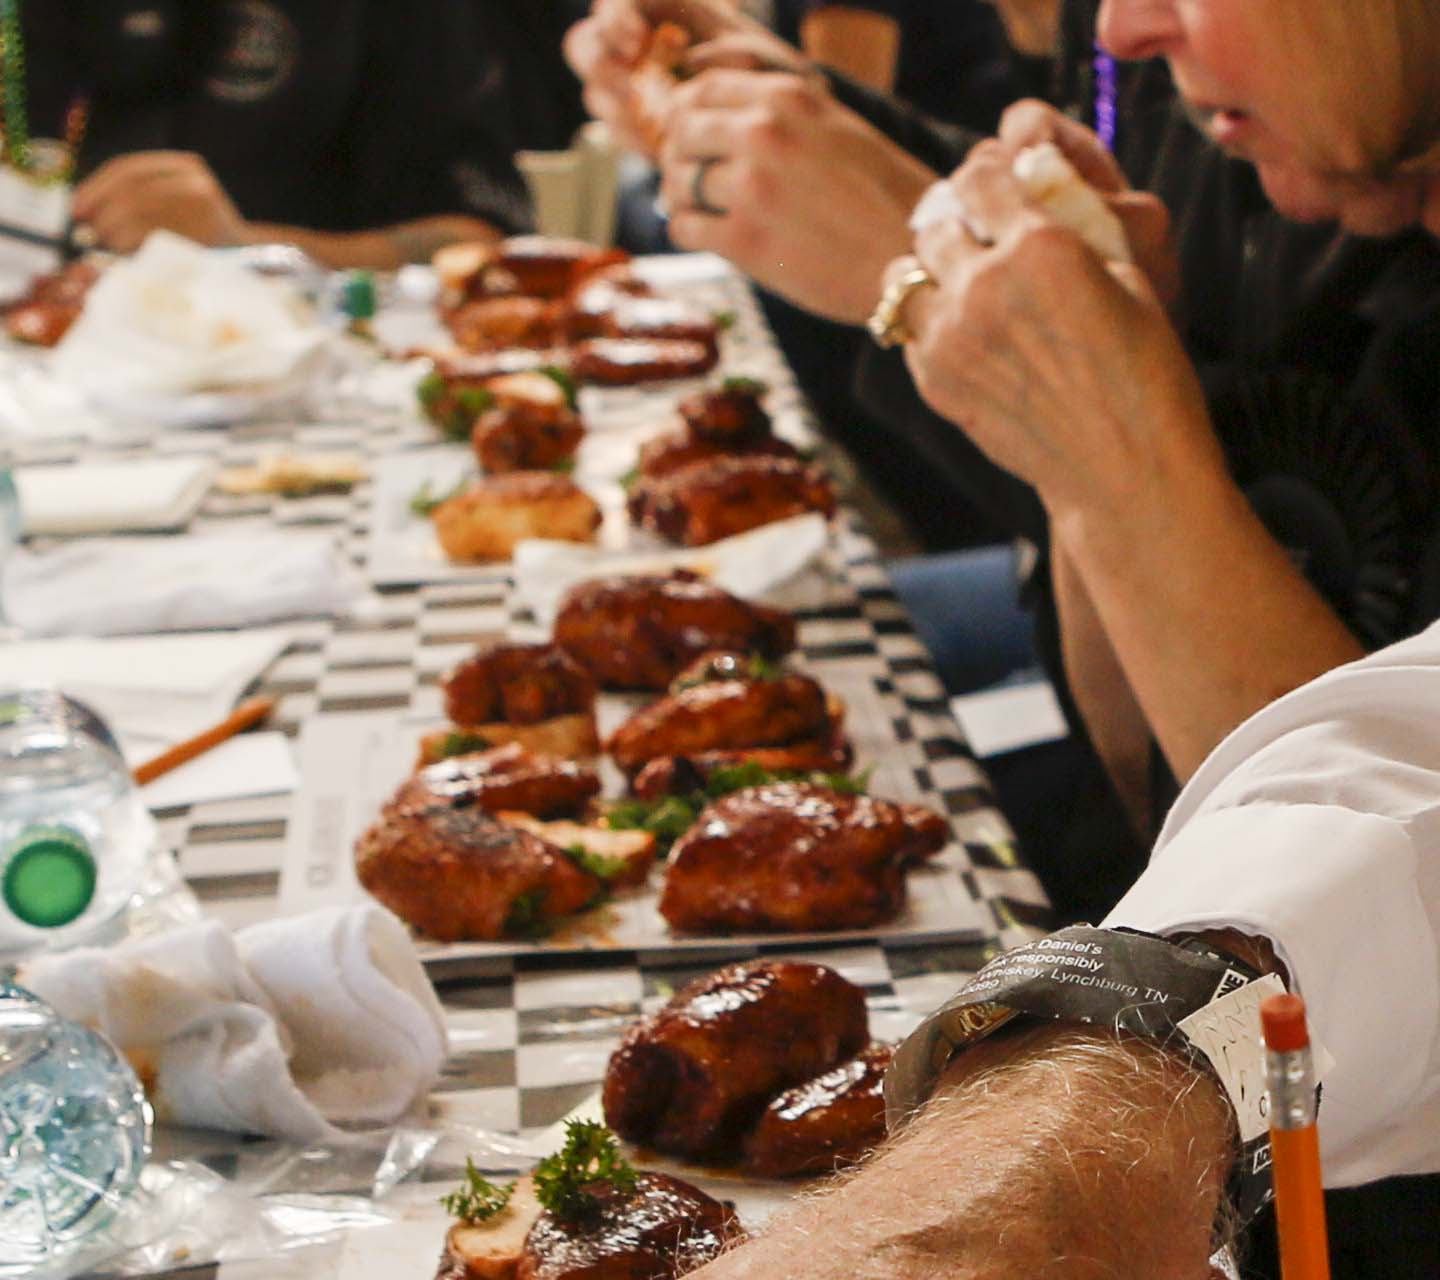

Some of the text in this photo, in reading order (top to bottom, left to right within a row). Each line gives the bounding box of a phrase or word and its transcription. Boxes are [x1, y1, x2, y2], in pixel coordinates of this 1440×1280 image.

[1038, 939, 1103, 956] Daniel's
[1010, 952, 1104, 972] responsibly
[1050, 969, 1139, 998] Lynchburg
[1144, 986, 1169, 1004] TN
